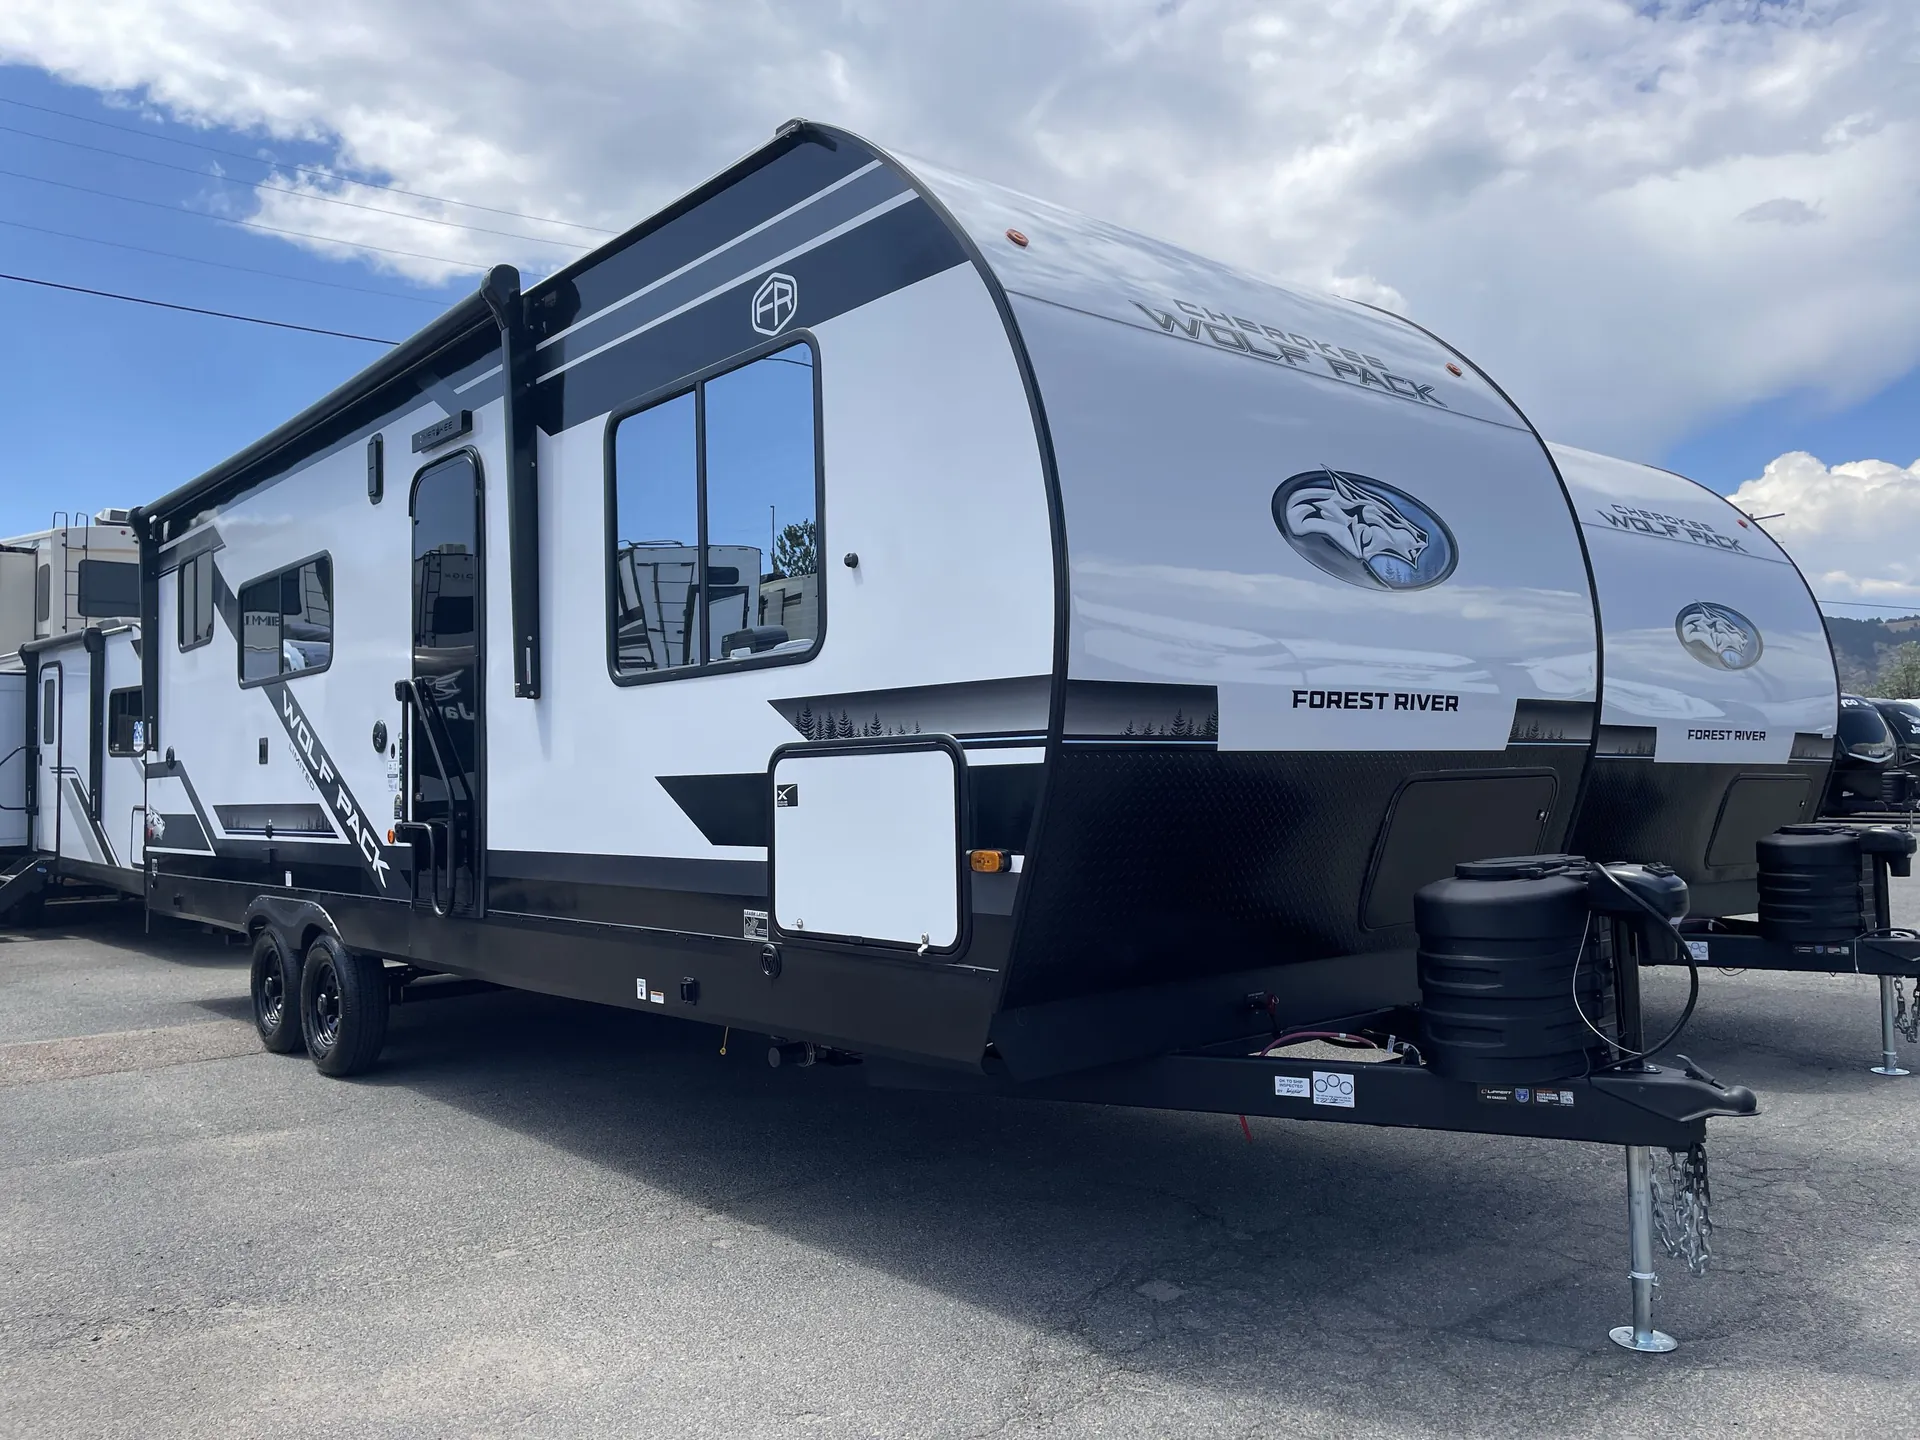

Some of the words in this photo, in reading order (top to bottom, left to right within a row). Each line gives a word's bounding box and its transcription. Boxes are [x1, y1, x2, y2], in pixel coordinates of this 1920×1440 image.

[1128, 299, 1311, 366] WOLF
[1317, 353, 1448, 408] PACK
[1173, 299, 1390, 371] CHEROKEE
[1595, 508, 1680, 538] WOLF
[1686, 528, 1749, 553] PACK
[1611, 504, 1716, 533] CHEROKEE
[1292, 690, 1389, 710] FOREST
[1394, 693, 1459, 712] RIVER
[1687, 729, 1732, 741] FOREST
[1734, 730, 1767, 741] RIVER
[282, 689, 335, 784] WOLF
[336, 783, 391, 888] PACK
[288, 742, 315, 791] LIMITED
